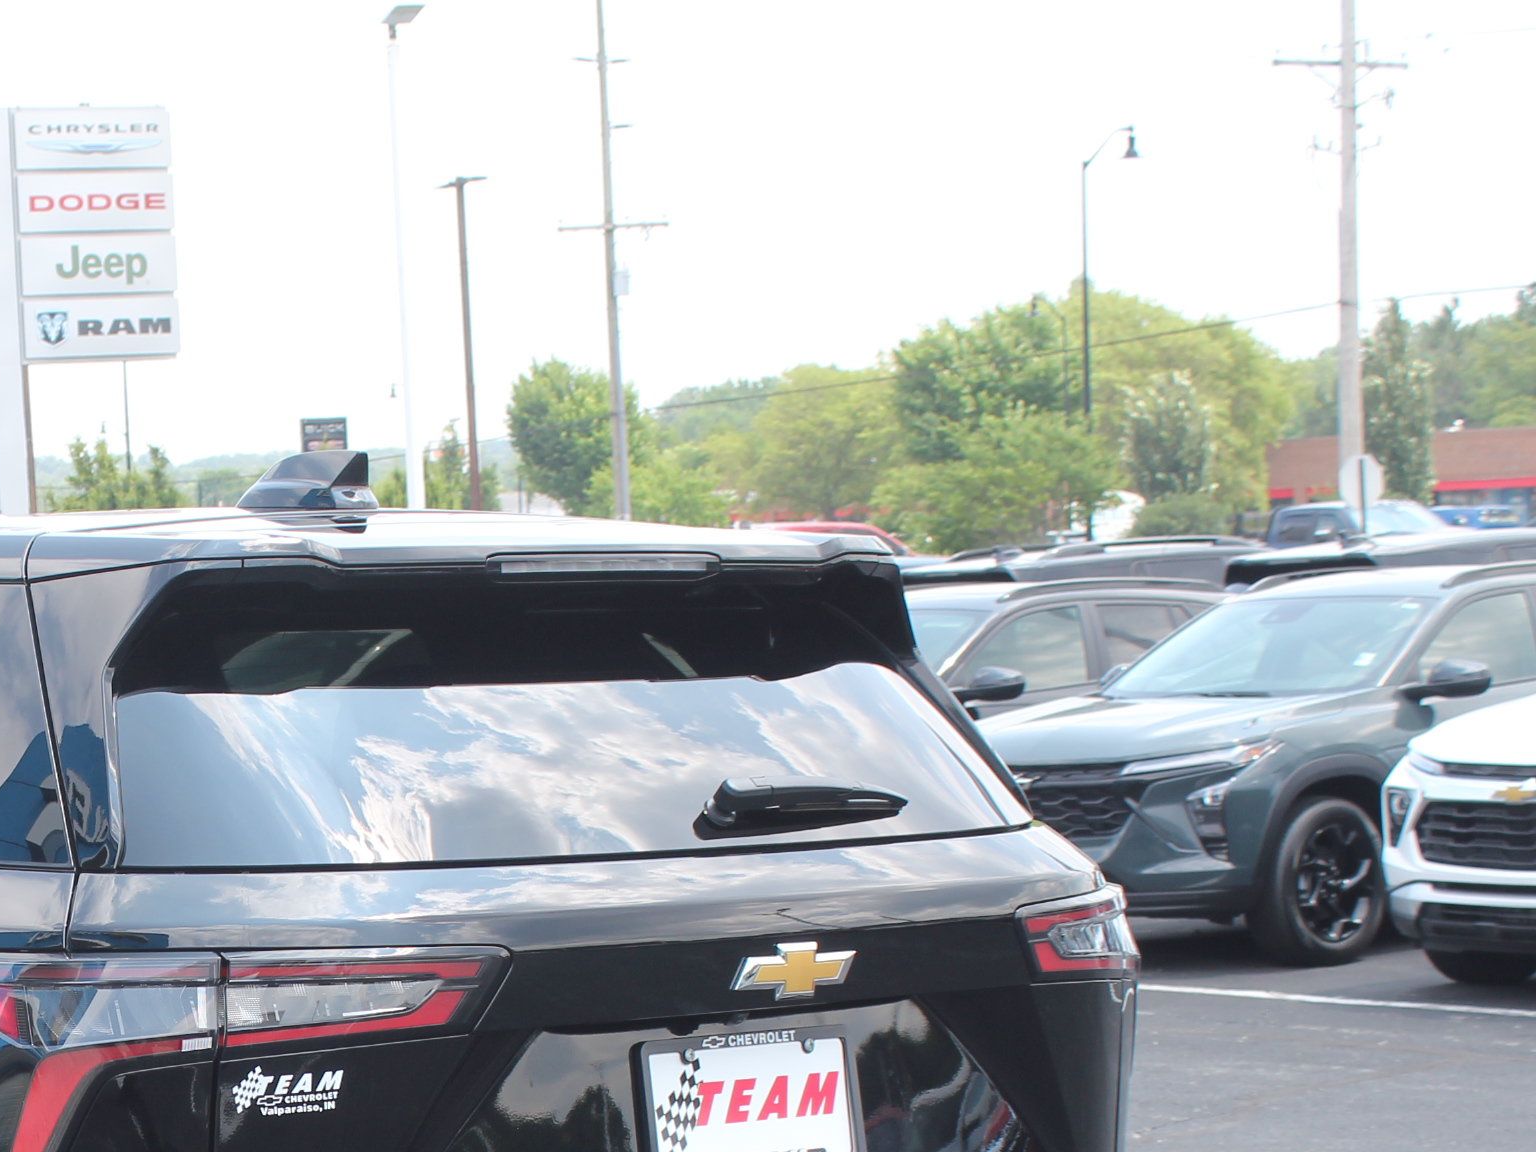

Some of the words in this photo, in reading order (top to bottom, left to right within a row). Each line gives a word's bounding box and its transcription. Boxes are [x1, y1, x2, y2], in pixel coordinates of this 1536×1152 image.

[27, 123, 159, 135] CHRYSLER
[29, 193, 166, 212] DODGE
[56, 245, 148, 285] Jeep
[77, 317, 172, 336] RAM
[304, 423, 344, 434] BUICK
[727, 1030, 796, 1047] CHEVROLET
[257, 1069, 344, 1096] TEAM
[284, 1091, 338, 1104] CHEVROLET
[696, 1071, 839, 1126] TEAM
[260, 1103, 323, 1117] Valparaiso,
[324, 1101, 336, 1111] IN
